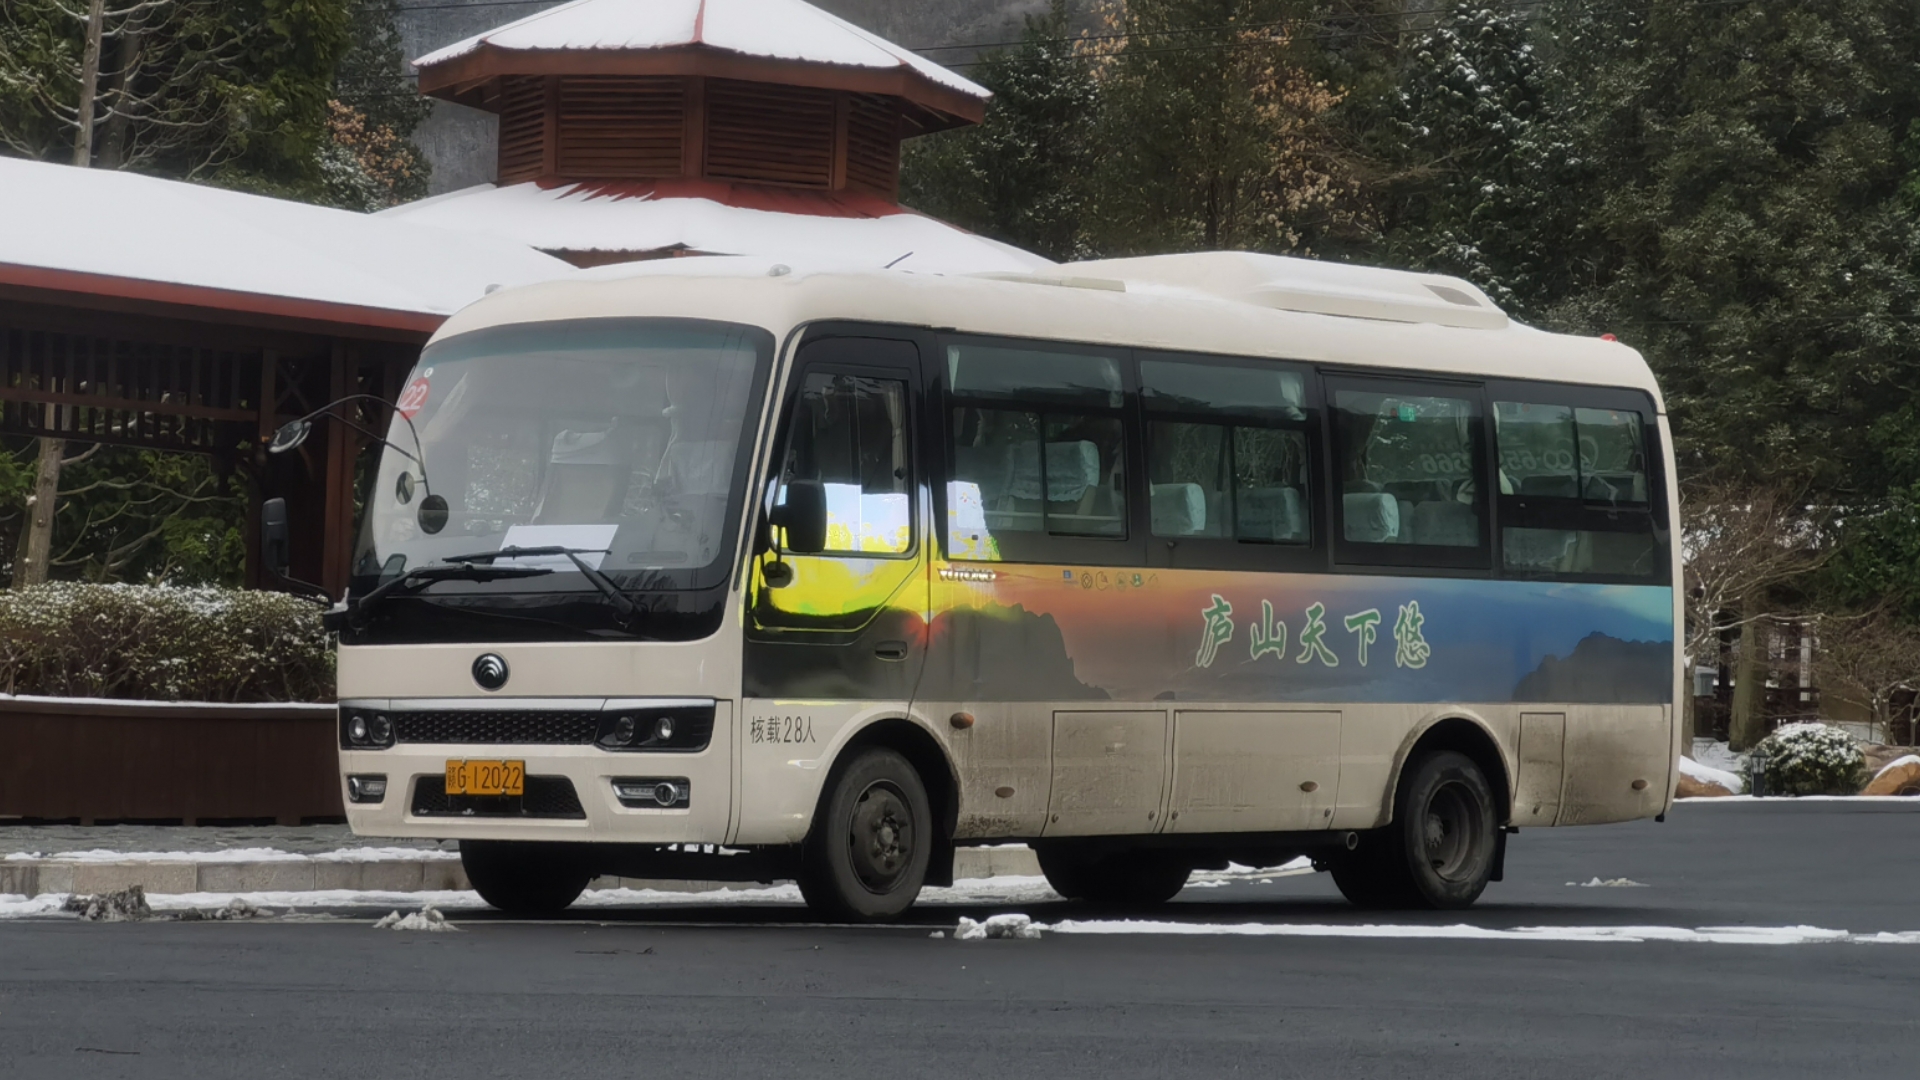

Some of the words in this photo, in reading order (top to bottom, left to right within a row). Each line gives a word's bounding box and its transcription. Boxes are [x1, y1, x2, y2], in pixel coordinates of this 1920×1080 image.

[937, 567, 996, 582] YUTONG
[1195, 593, 1431, 669] 庐山天下悠
[750, 715, 817, 744] 核载28人
